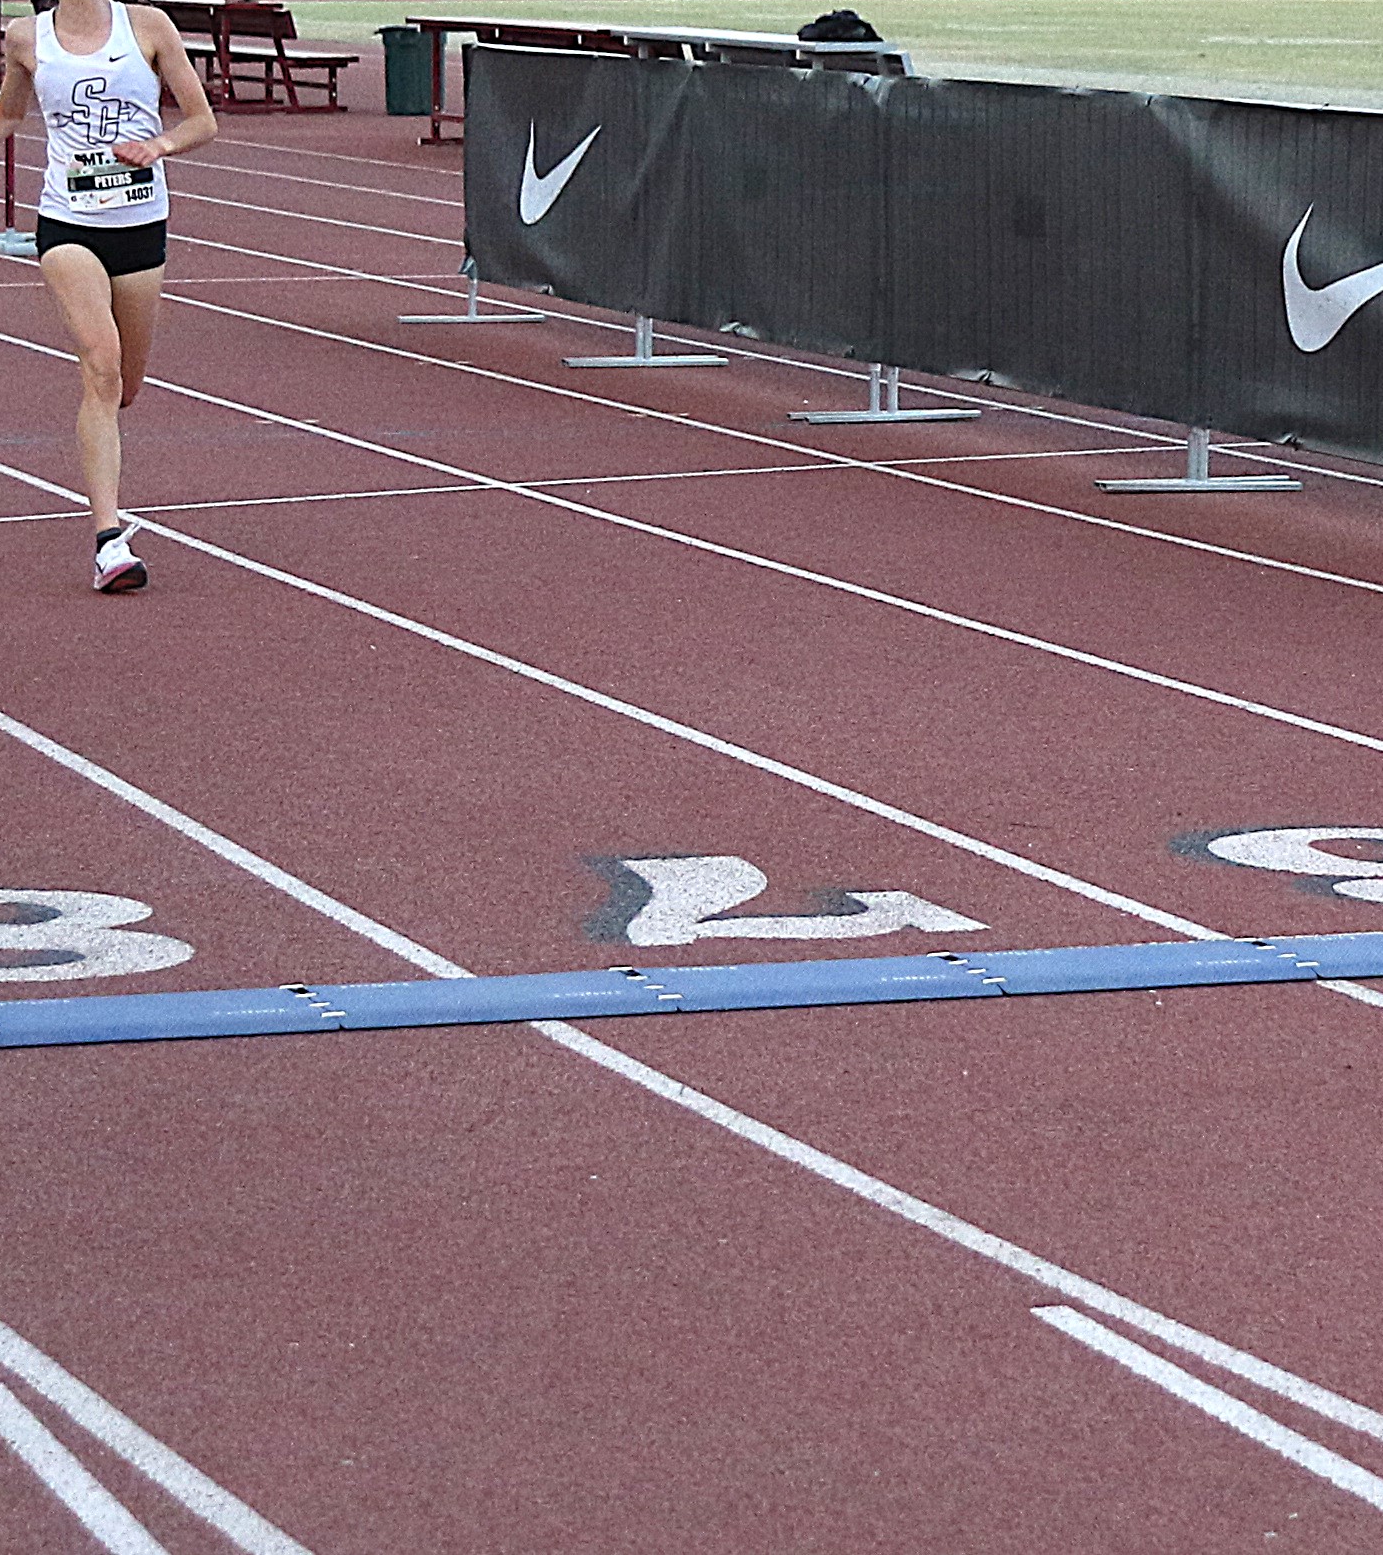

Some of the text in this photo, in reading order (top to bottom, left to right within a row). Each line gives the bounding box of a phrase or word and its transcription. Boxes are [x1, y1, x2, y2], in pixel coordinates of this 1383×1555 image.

[83, 152, 111, 166] MT.
[94, 172, 133, 189] PETERS
[125, 185, 154, 202] 14031
[621, 855, 990, 947] 7
